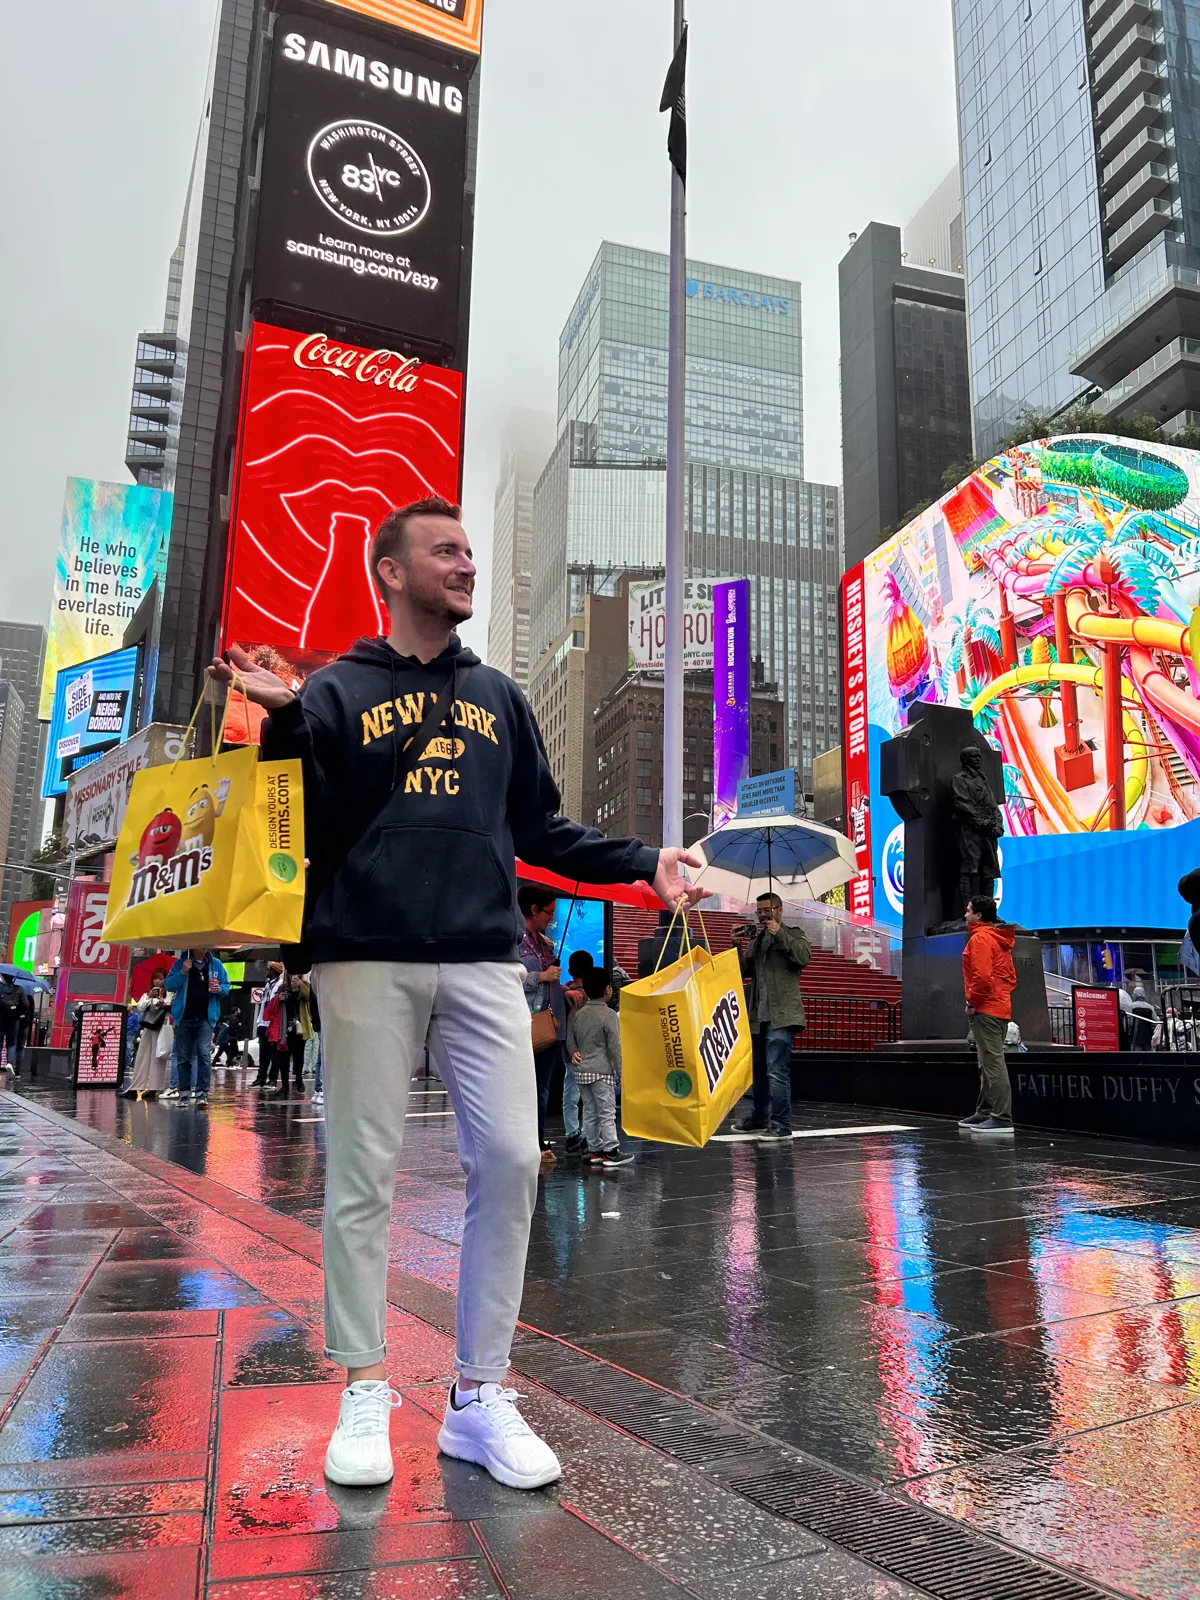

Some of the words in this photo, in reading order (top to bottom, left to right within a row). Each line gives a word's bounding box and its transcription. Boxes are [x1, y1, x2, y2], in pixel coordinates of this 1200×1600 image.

[284, 33, 463, 113] SAMSUNG
[320, 126, 386, 150] WASHINGTON
[388, 139, 420, 176] STREET
[319, 180, 338, 203] NEW
[376, 219, 390, 229] NY
[393, 205, 419, 226] 10014
[319, 233, 356, 253] Learn
[359, 246, 394, 263] more
[396, 255, 411, 267] at
[286, 239, 439, 290] samsung.com/837
[703, 282, 789, 314] BARCLAYS
[80, 536, 100, 553] He
[106, 541, 136, 558] who
[74, 555, 138, 578] believes
[66, 574, 80, 592] in
[86, 580, 109, 595] me
[115, 580, 142, 599] has
[641, 583, 693, 612] LITE
[58, 598, 135, 618] everlastin
[85, 617, 113, 636] life.
[847, 578, 864, 688] HERSHEY'S
[635, 660, 664, 668] Westside
[68, 694, 92, 720] STREET
[72, 684, 87, 704] SIDE
[96, 702, 120, 716] NEIGH-
[361, 692, 425, 745] NEW
[431, 692, 499, 745] ORK
[88, 716, 122, 731] BORHOOD
[848, 690, 865, 759] STORE
[74, 770, 117, 807] MISSIONARY
[116, 755, 142, 784] STYLE
[268, 775, 277, 785] AT
[404, 767, 460, 795] NYC
[268, 787, 277, 815] YOURS
[278, 773, 291, 849] mms.com
[268, 816, 278, 849] DESIGN
[659, 1007, 667, 1016] AT
[661, 1017, 671, 1042] YOURS
[667, 1004, 685, 1068] mms.com
[664, 1042, 676, 1068] DESIGN
[1017, 1073, 1095, 1099] FATHER
[1102, 1075, 1180, 1103] DUFFY
